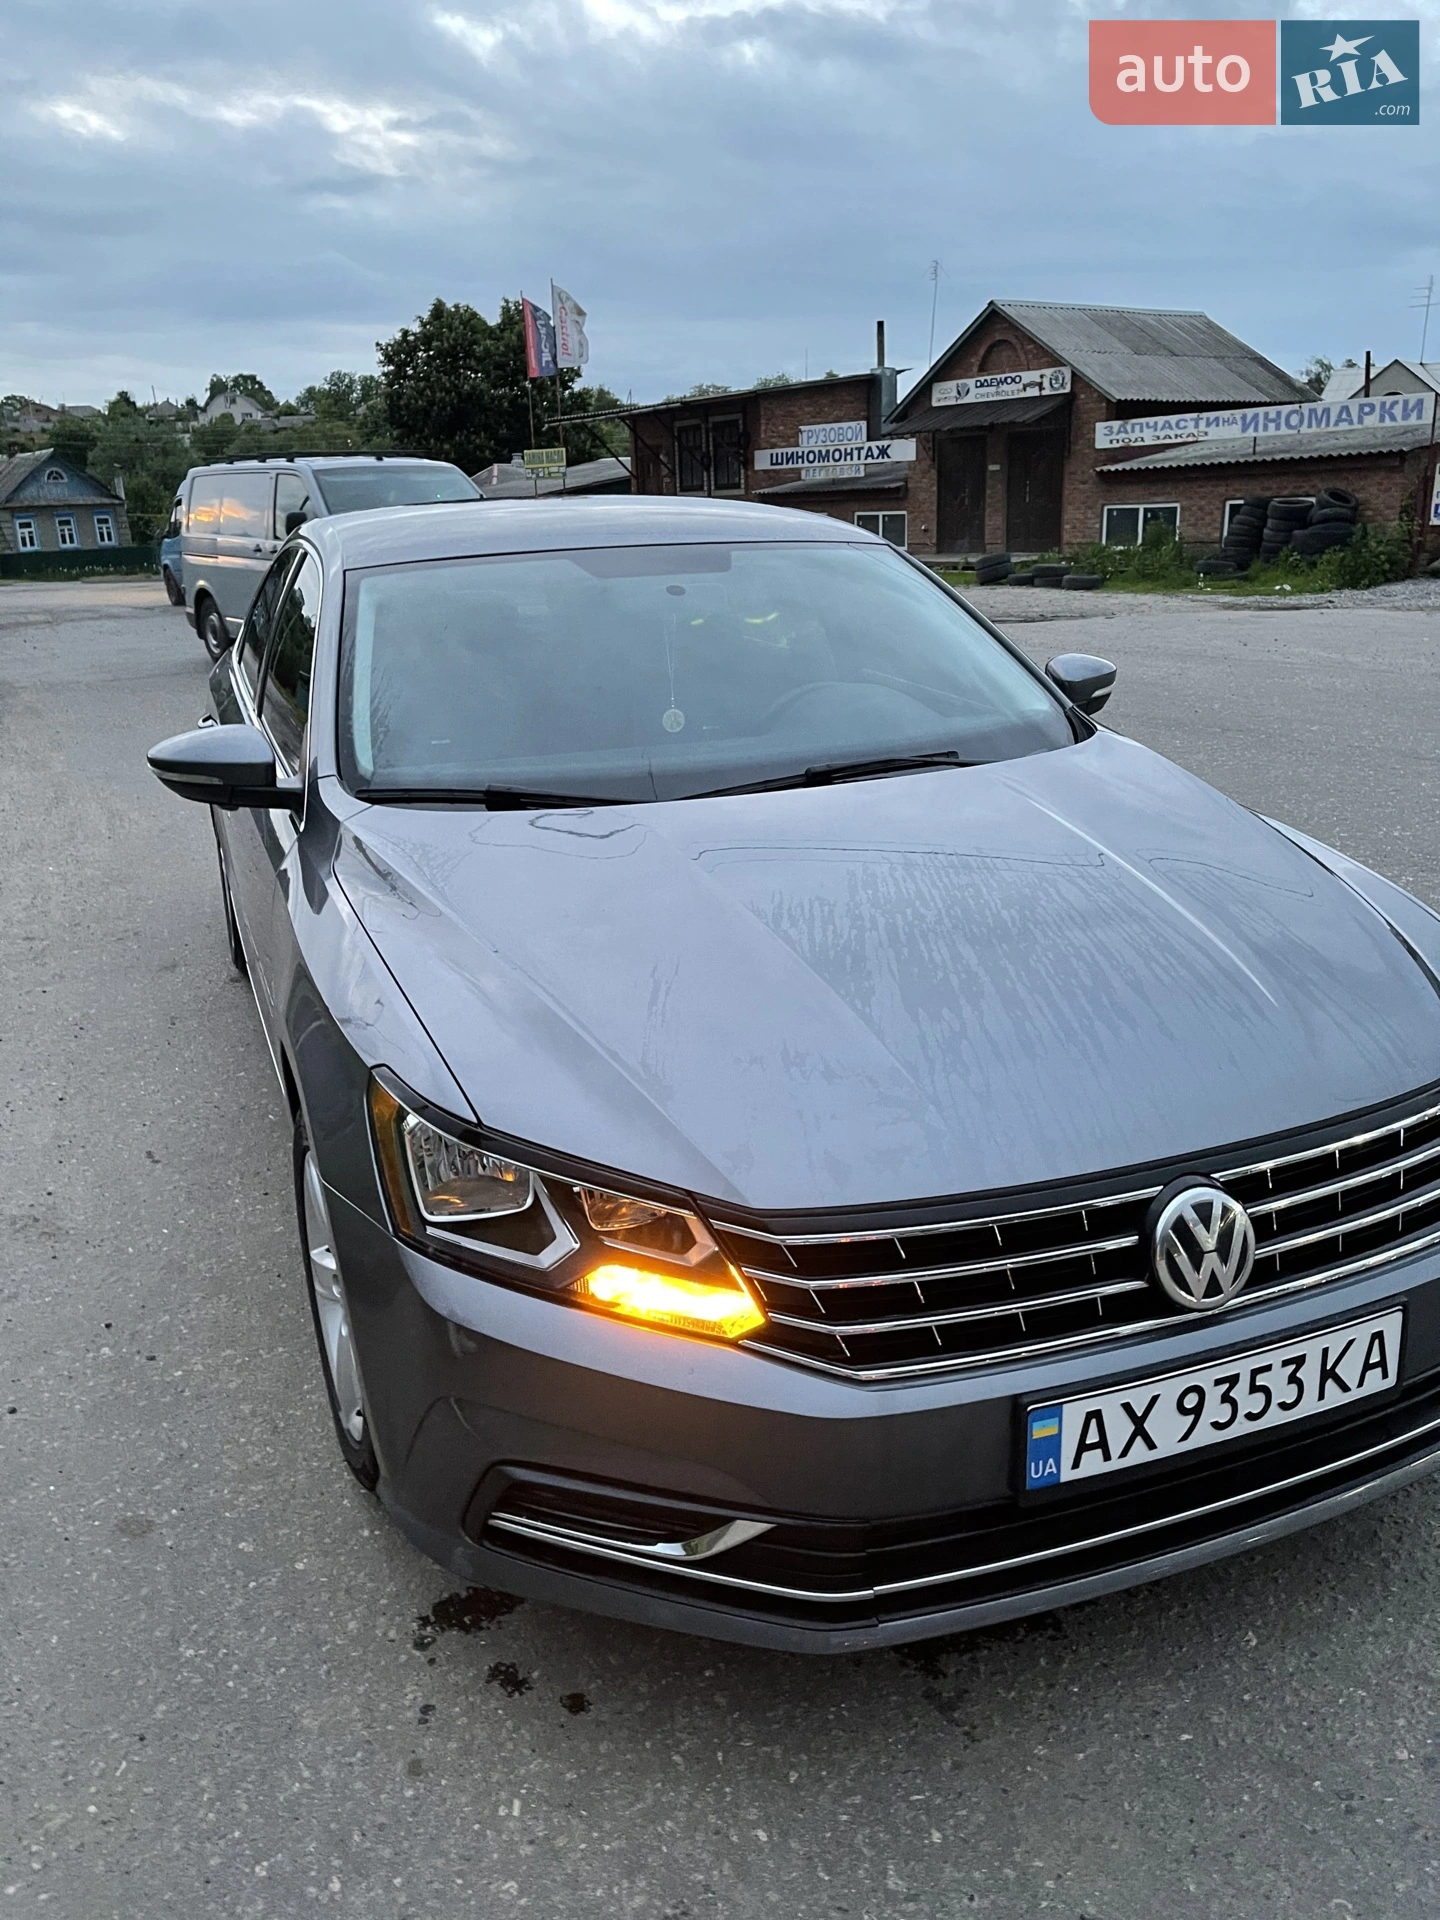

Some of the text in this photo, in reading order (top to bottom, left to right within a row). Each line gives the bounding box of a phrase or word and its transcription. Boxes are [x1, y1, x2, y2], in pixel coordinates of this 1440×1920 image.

[974, 374, 1023, 389] DAEWOO
[974, 388, 1023, 400] CHEVROLET
[1103, 397, 1425, 438] ЗАПЧАСТИ НА ИНОМАРКИ
[800, 422, 864, 446] ГРУЗОВОЙ
[1108, 430, 1210, 445] ПОД ЗАКАЗ
[769, 443, 892, 467] ШИНОМОНТАЖ
[1176, 1353, 1308, 1444] 9353
[1030, 1457, 1058, 1479] UA
